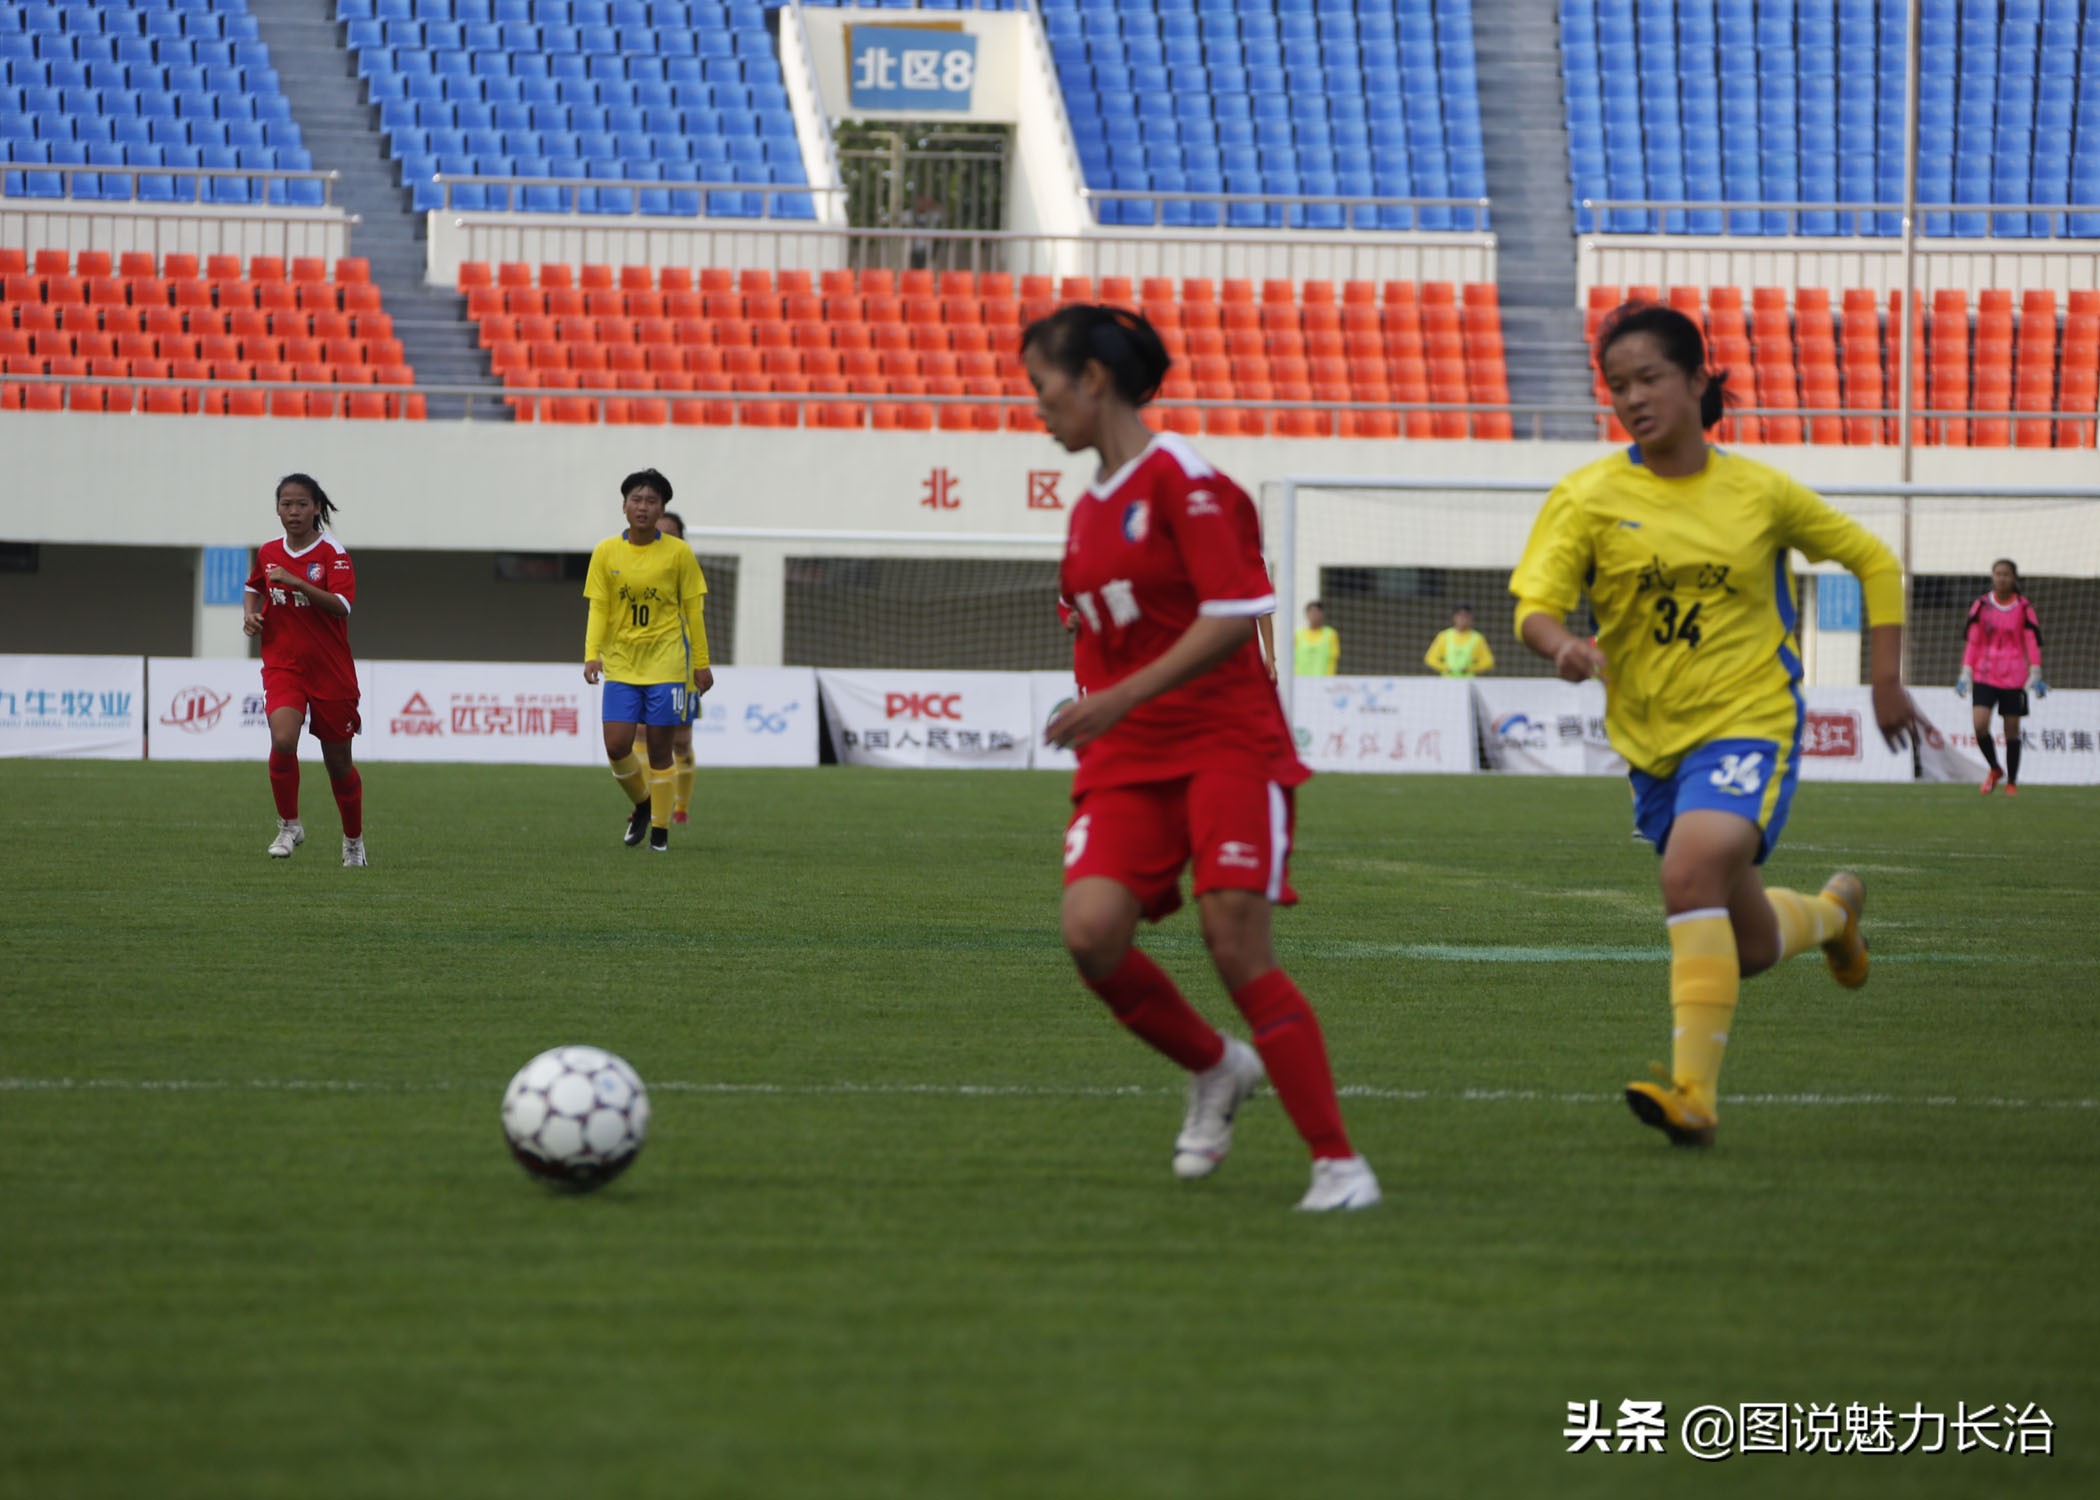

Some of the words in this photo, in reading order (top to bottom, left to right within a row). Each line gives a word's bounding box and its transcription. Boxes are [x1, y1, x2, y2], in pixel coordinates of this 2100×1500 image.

[854, 47, 973, 91] 北区8
[1637, 555, 1738, 593] 武汉
[619, 584, 661, 602] 武汉
[631, 604, 649, 627] 10
[1654, 596, 1702, 648] 34
[671, 688, 684, 710] 10
[885, 692, 962, 720] PICC
[391, 719, 443, 735] PEAK
[451, 706, 579, 735] 匹克体育
[842, 727, 1013, 749] 中国人民保险
[1710, 751, 1763, 794] 34
